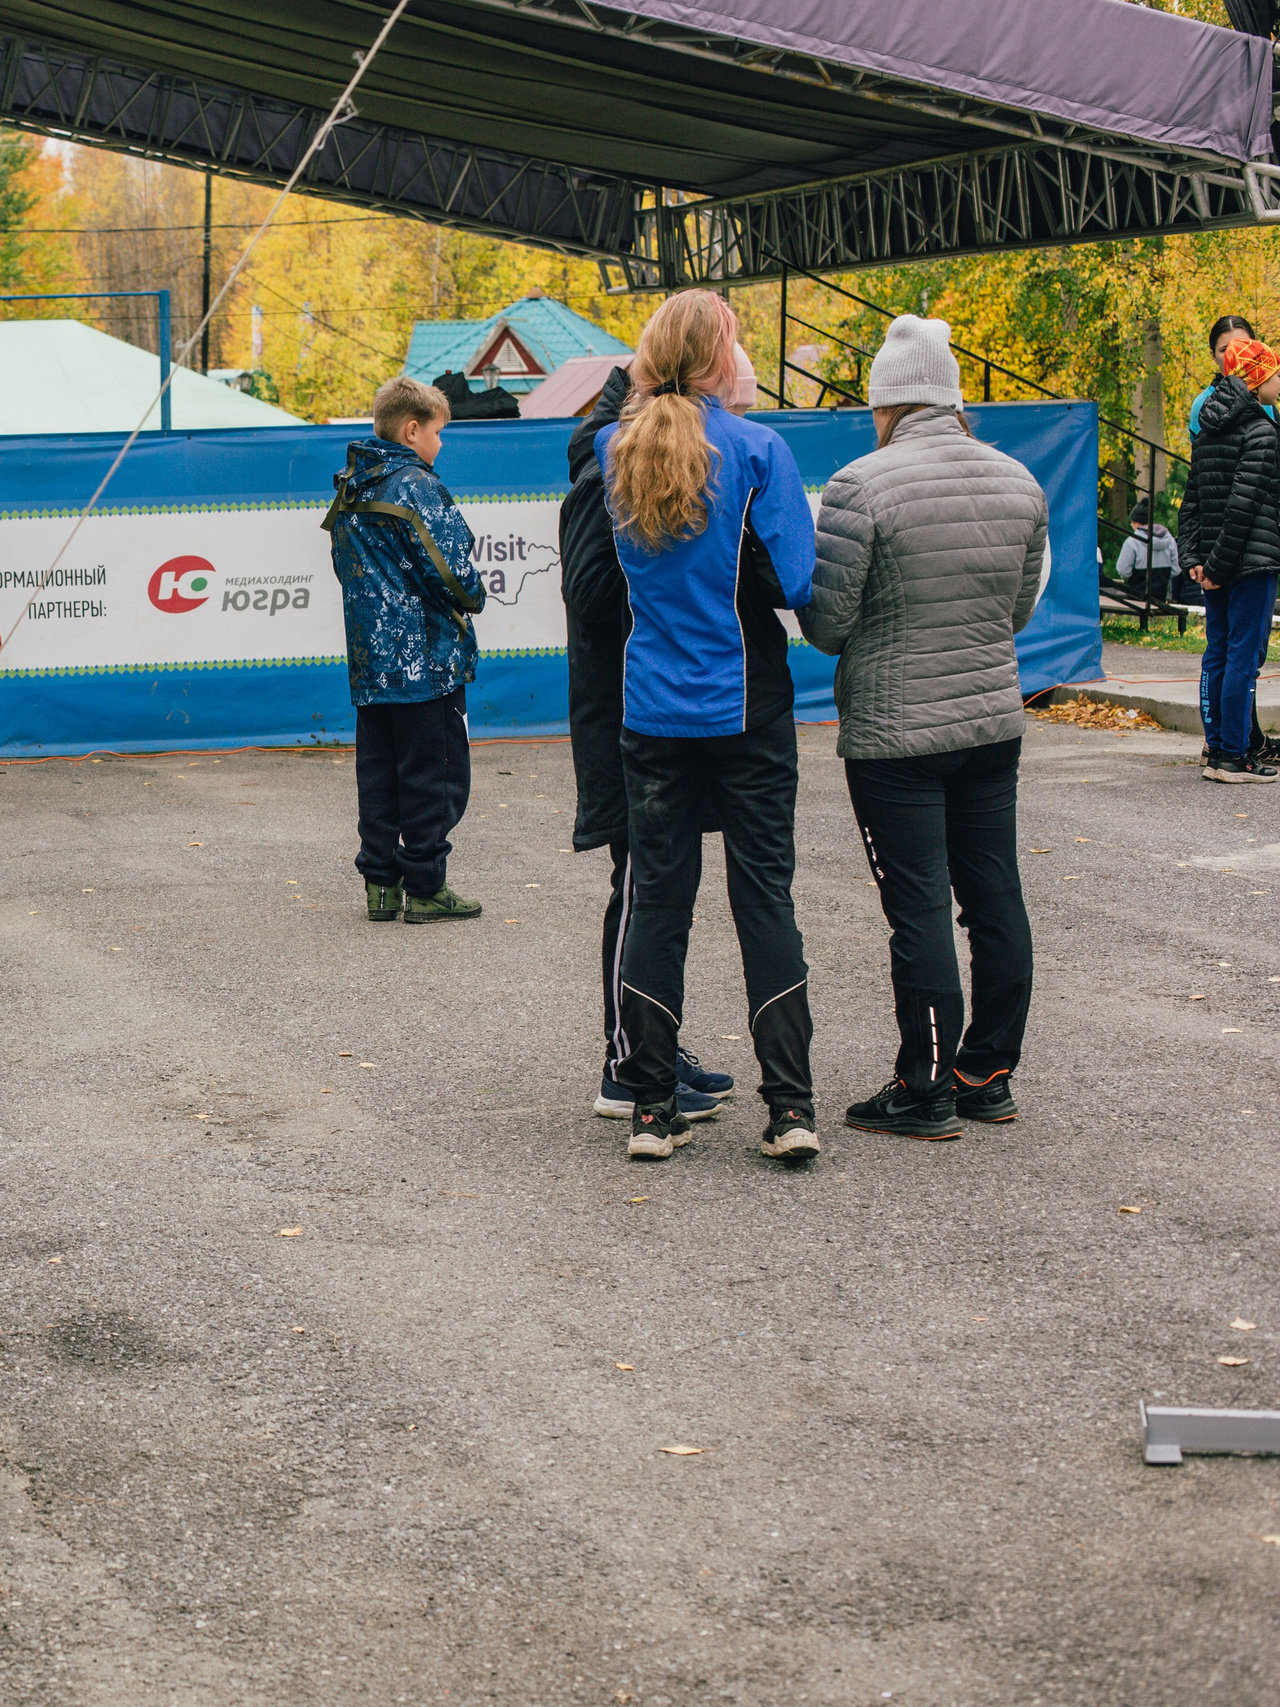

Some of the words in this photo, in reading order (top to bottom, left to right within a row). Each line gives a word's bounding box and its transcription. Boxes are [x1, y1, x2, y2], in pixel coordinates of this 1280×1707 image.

[471, 534, 527, 562] Visit
[224, 574, 315, 587] МЕДИАХОЛДИНГ
[28, 600, 108, 620] ПАРТНЕРЫ:
[221, 587, 311, 617] югра
